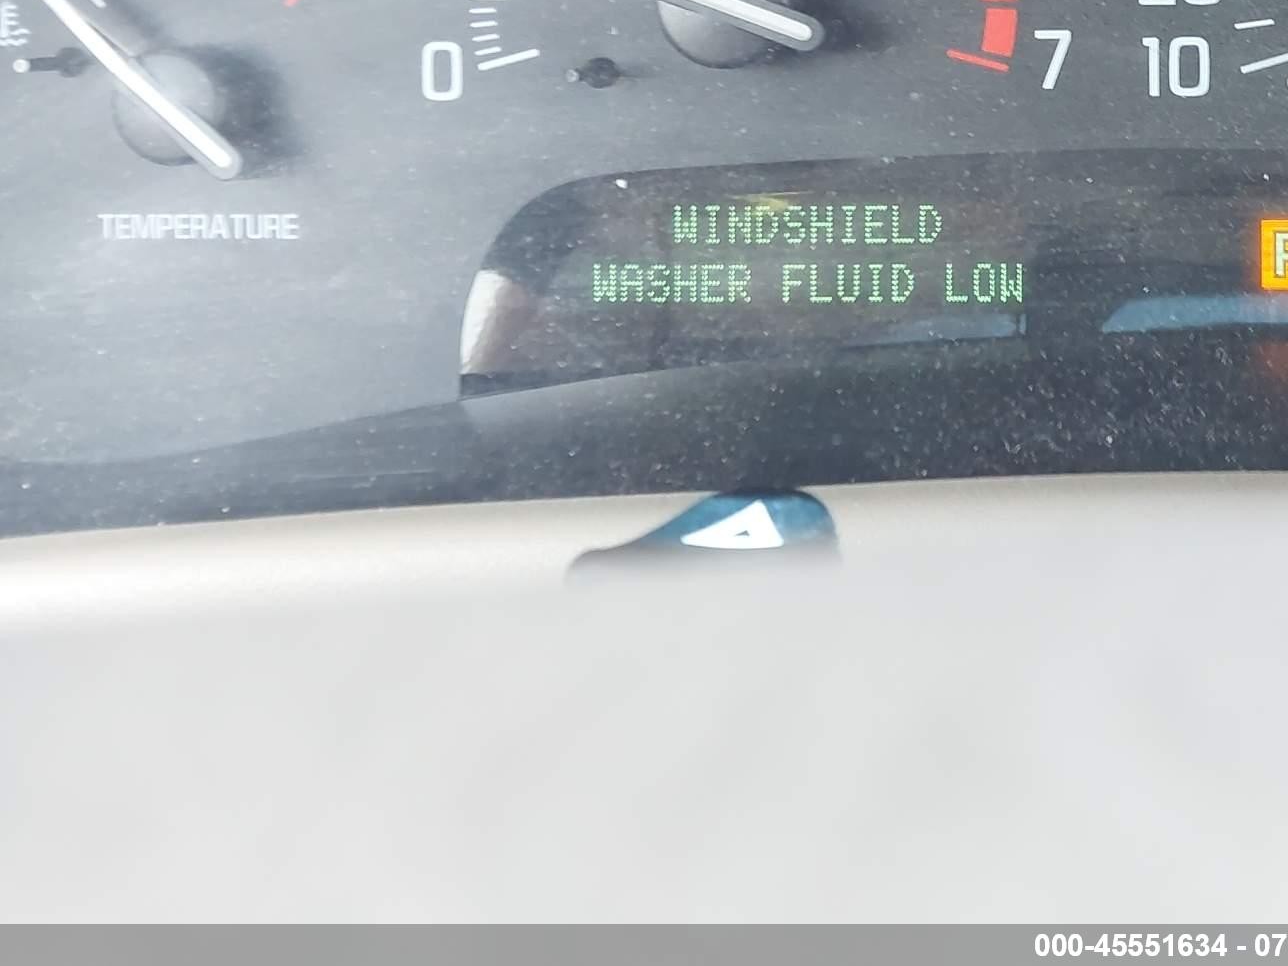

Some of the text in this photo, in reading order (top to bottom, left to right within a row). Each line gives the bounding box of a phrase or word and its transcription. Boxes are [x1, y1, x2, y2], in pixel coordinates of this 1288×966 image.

[421, 41, 463, 102] 0
[1034, 29, 1072, 90] 7
[1142, 36, 1210, 98] 10
[97, 213, 300, 241] TEMPERATURE
[673, 204, 942, 245] WINDSHIELD
[593, 263, 1023, 303] WASHER FLUID LOW
